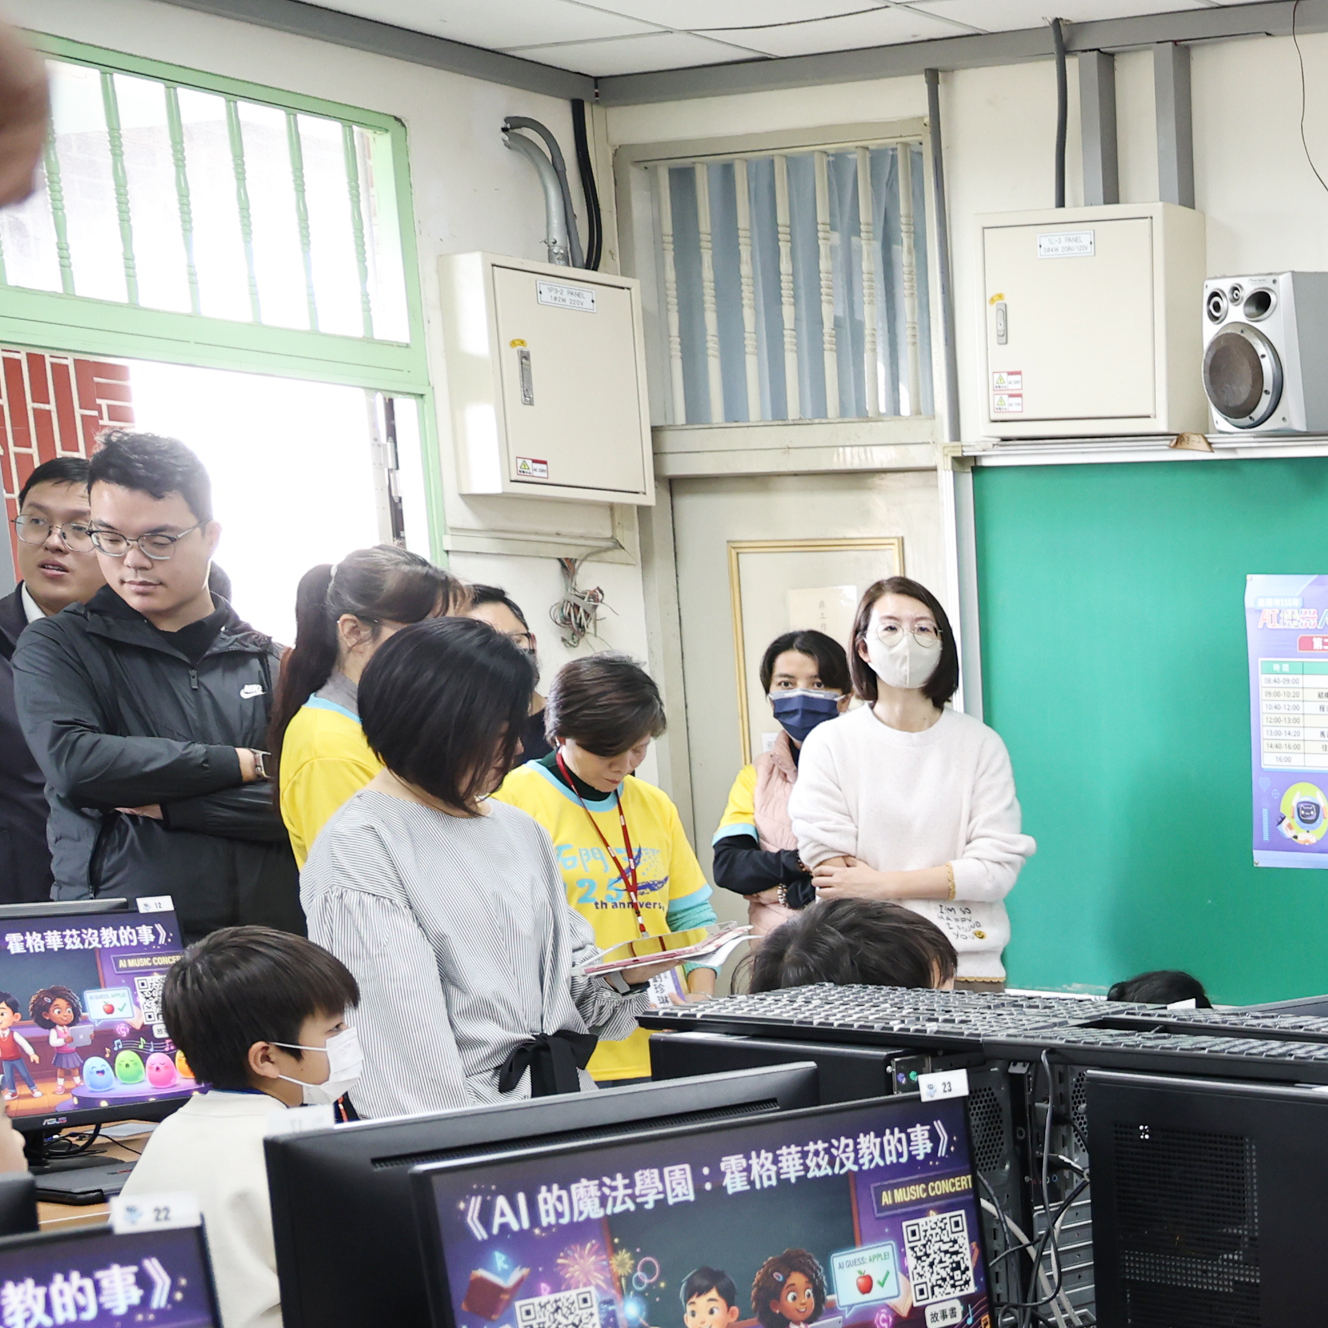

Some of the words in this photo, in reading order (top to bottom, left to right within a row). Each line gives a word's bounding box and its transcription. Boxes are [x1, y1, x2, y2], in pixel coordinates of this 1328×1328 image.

[566, 290, 586, 299] PANEL
[1264, 690, 1300, 698] 09:00-10:20
[1265, 703, 1301, 711] 10:40-12:00
[1265, 716, 1301, 725] 12:00-13:00
[1266, 729, 1301, 738] 13:00-14:20
[1266, 742, 1302, 751] 14:40-16:00
[1275, 755, 1292, 763] 16:00
[594, 900, 608, 910] th
[118, 958, 127, 969] AI
[128, 956, 152, 968] MUSIC
[942, 1081, 953, 1094] 23
[881, 1190, 892, 1206] AI
[894, 1183, 927, 1203] MUSIC
[928, 1174, 972, 1197] CONCERT
[154, 1206, 172, 1222] 22
